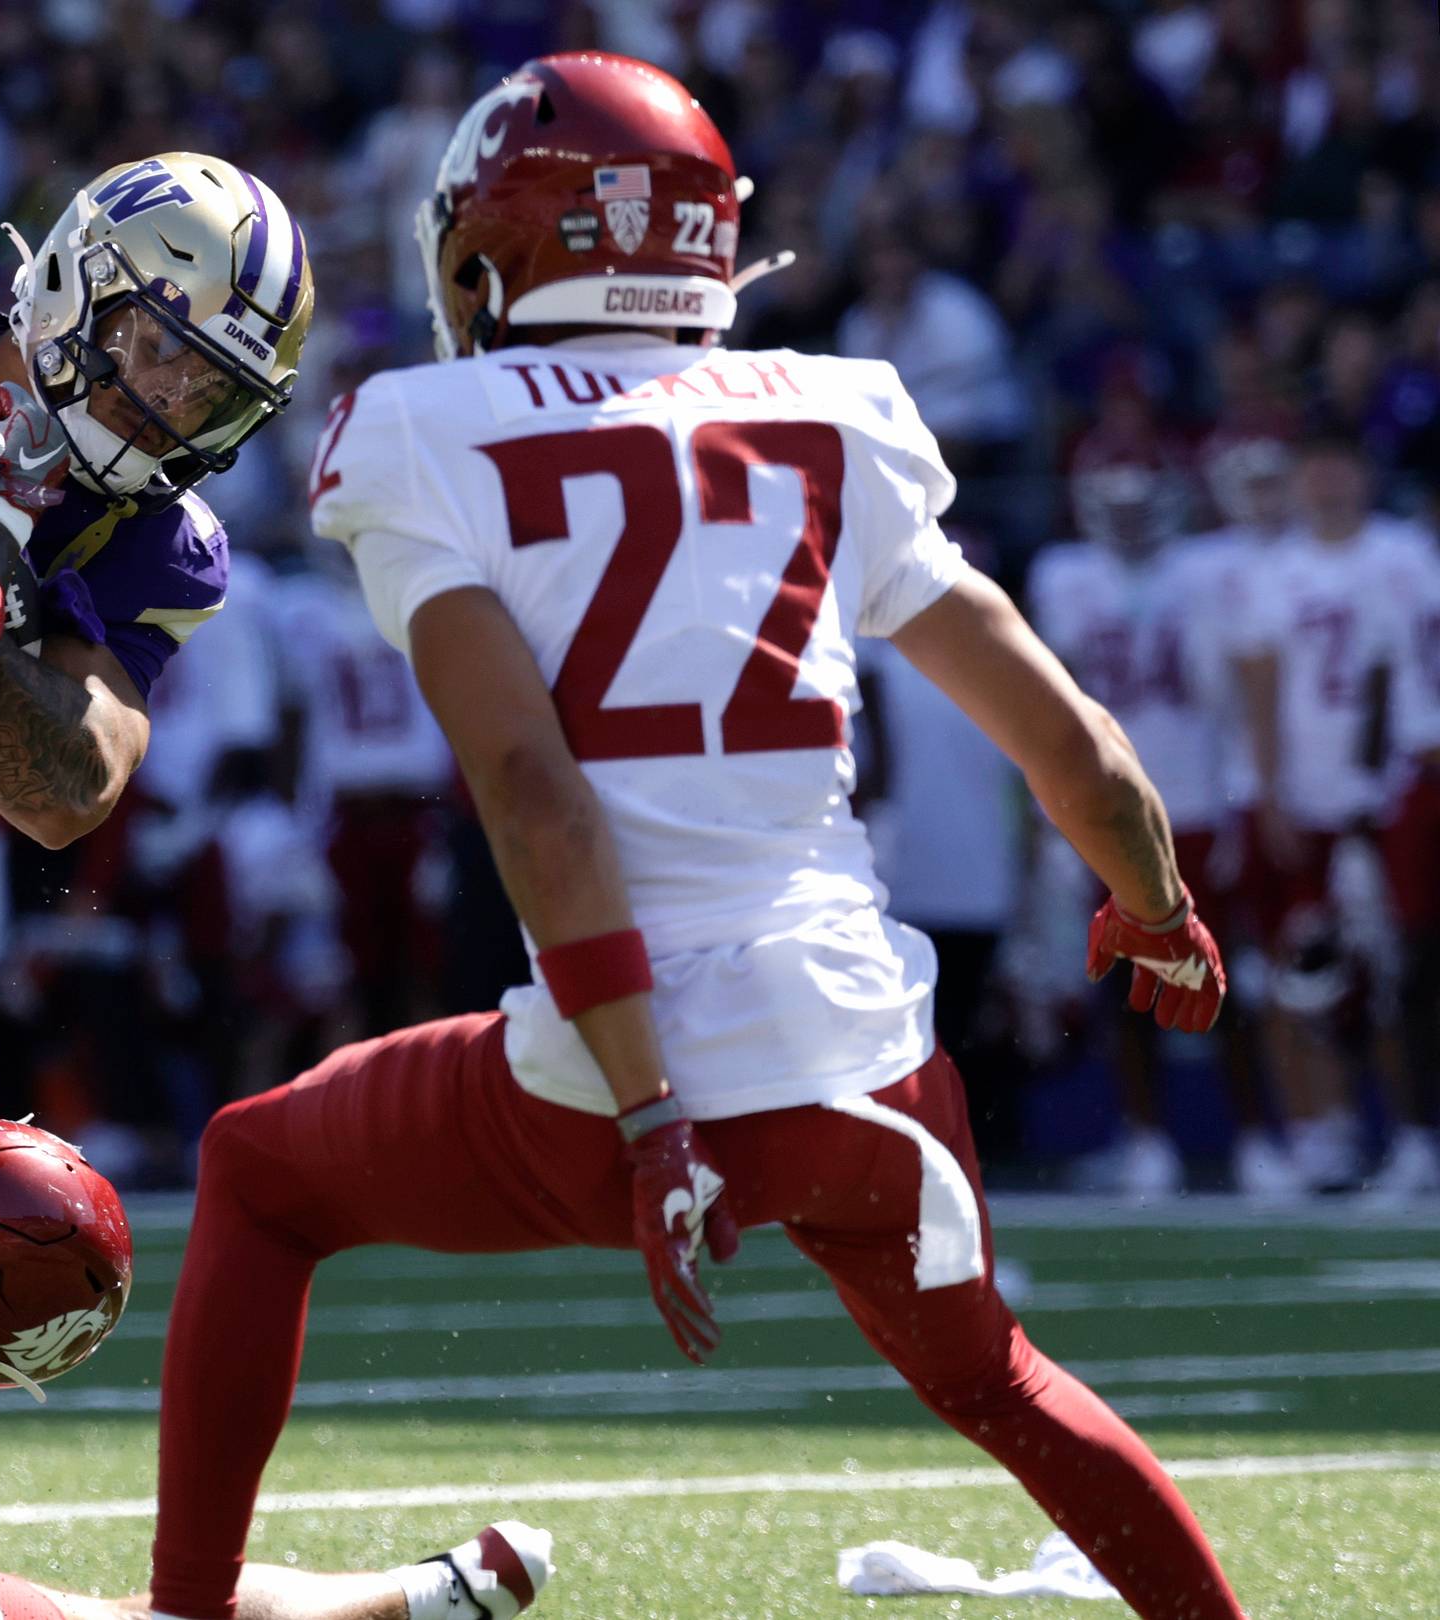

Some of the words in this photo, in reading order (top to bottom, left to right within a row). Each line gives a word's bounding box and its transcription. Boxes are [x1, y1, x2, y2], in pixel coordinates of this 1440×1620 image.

[93, 159, 194, 226] W
[672, 202, 714, 255] 22
[162, 281, 182, 301] W
[605, 286, 705, 315] COUGARS
[224, 321, 270, 361] DAWGS
[500, 361, 803, 408] TUCKER
[471, 421, 846, 761] 22
